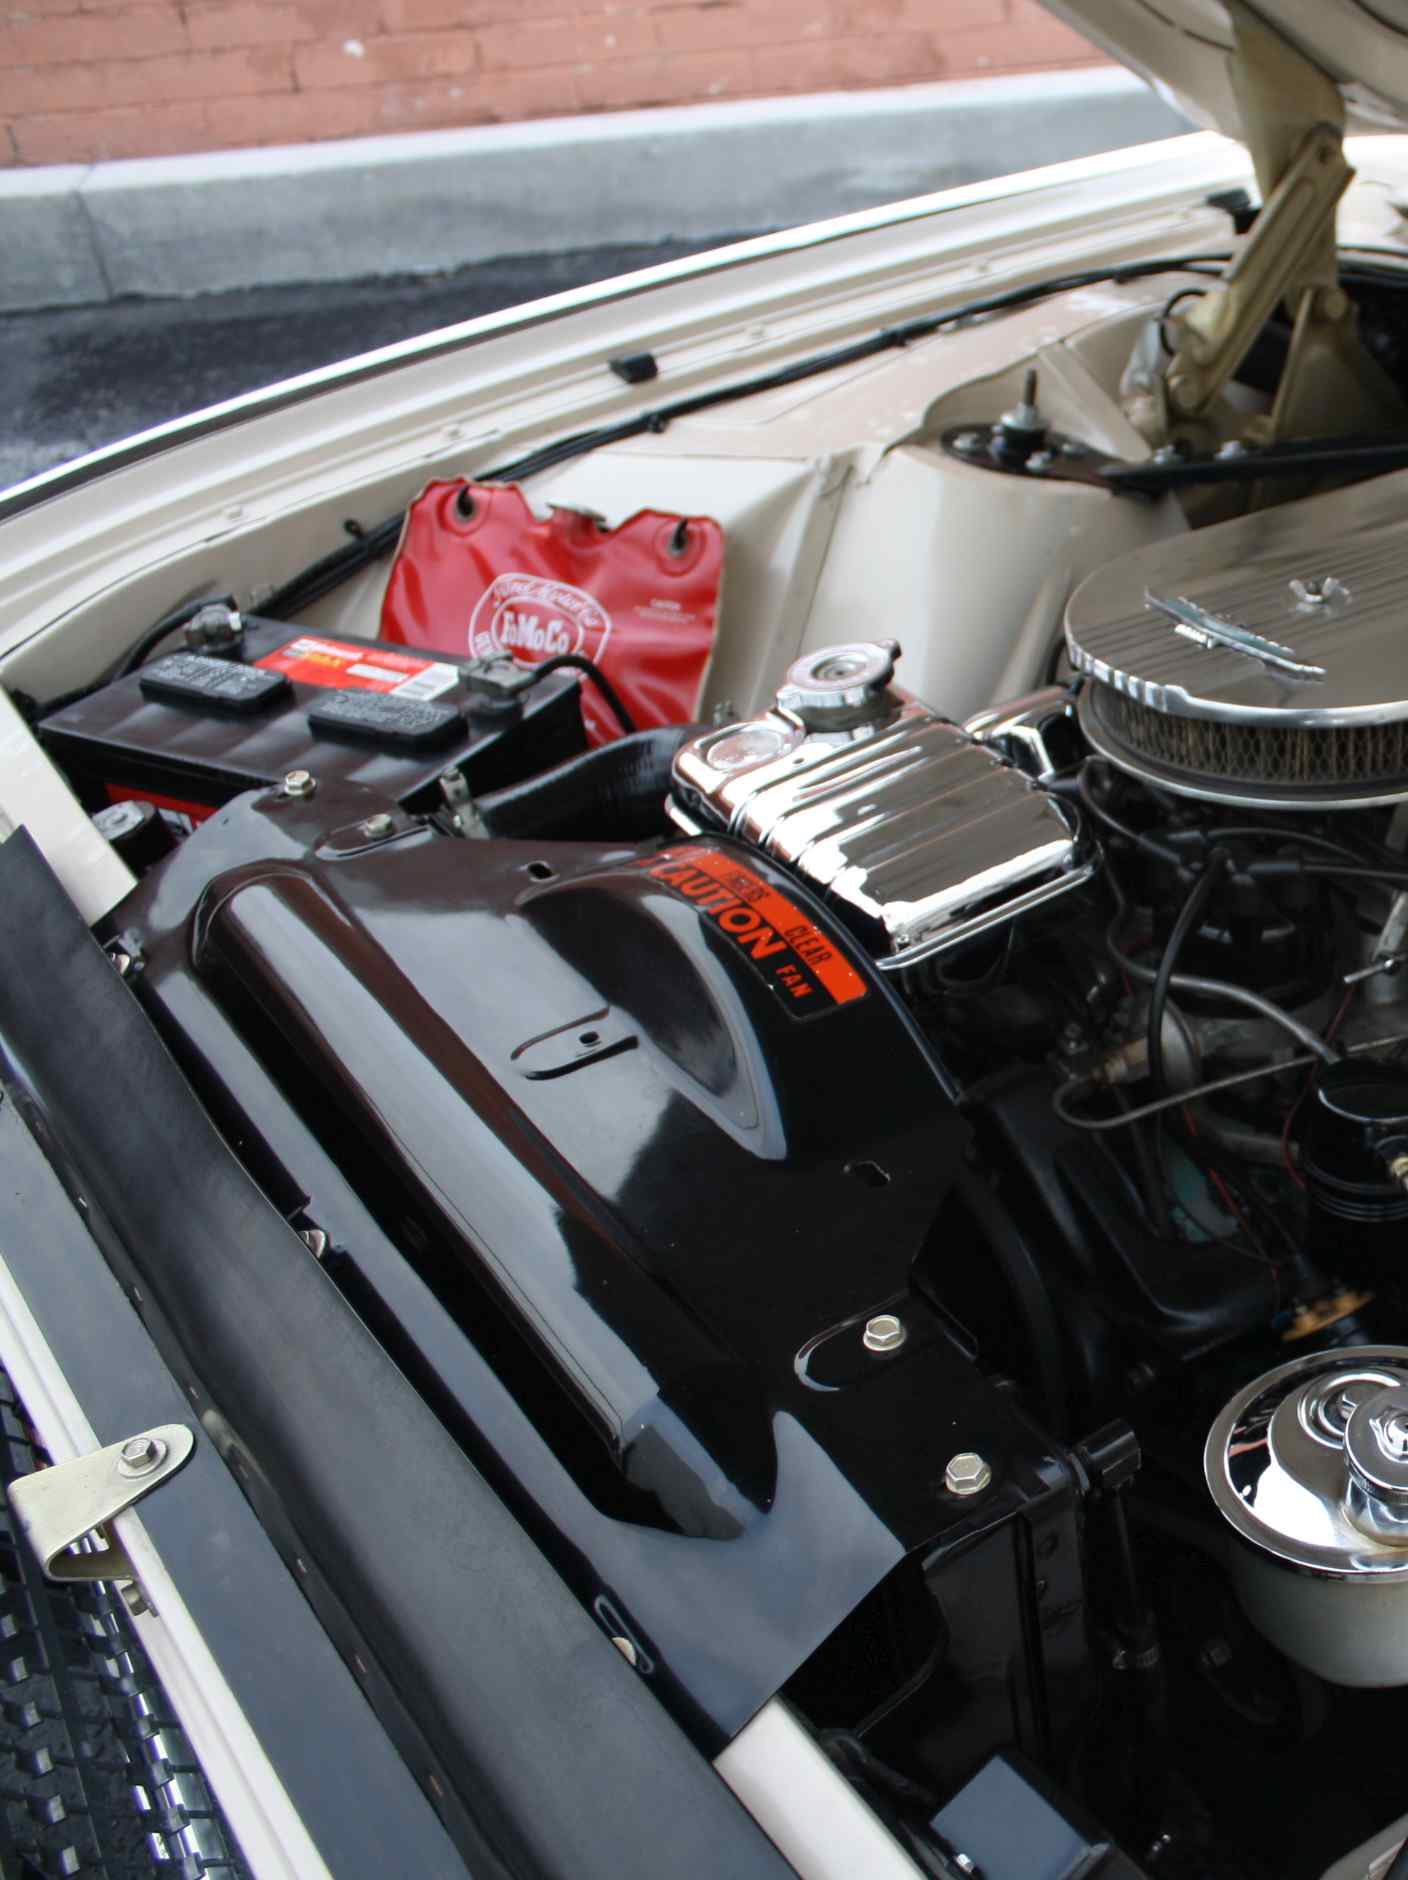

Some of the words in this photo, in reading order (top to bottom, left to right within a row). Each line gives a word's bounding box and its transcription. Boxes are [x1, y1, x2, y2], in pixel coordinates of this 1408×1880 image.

[502, 610, 570, 655] FoMoCo
[652, 865, 788, 960] CAUTION
[775, 964, 815, 998] FAN
[784, 924, 833, 966] CLEAR
